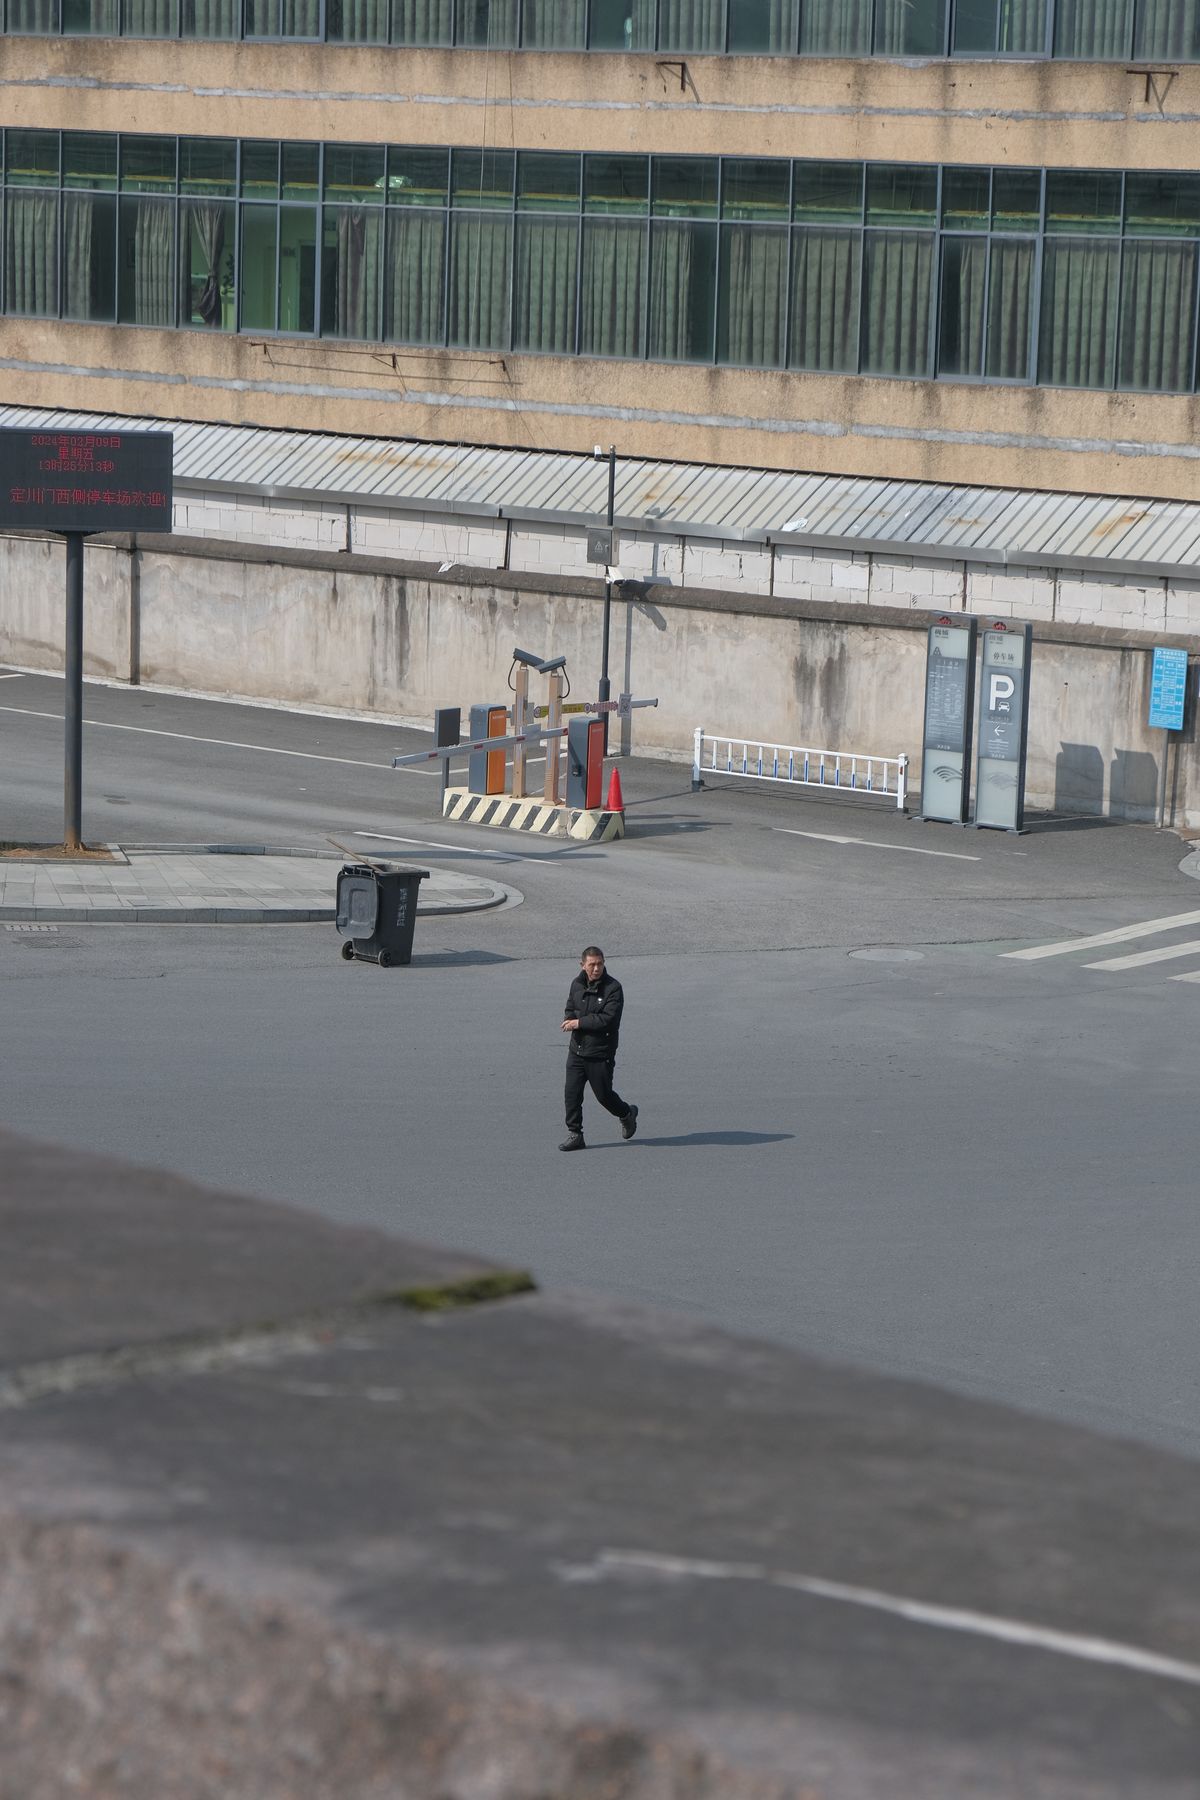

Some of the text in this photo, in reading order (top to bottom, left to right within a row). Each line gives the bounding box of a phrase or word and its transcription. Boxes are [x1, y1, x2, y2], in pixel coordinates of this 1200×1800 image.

[31, 434, 121, 448] 2024年02月09日
[59, 447, 93, 460] 星期五
[10, 487, 165, 506] 定川门西侧停车场欢迎
[989, 674, 1015, 711] P
